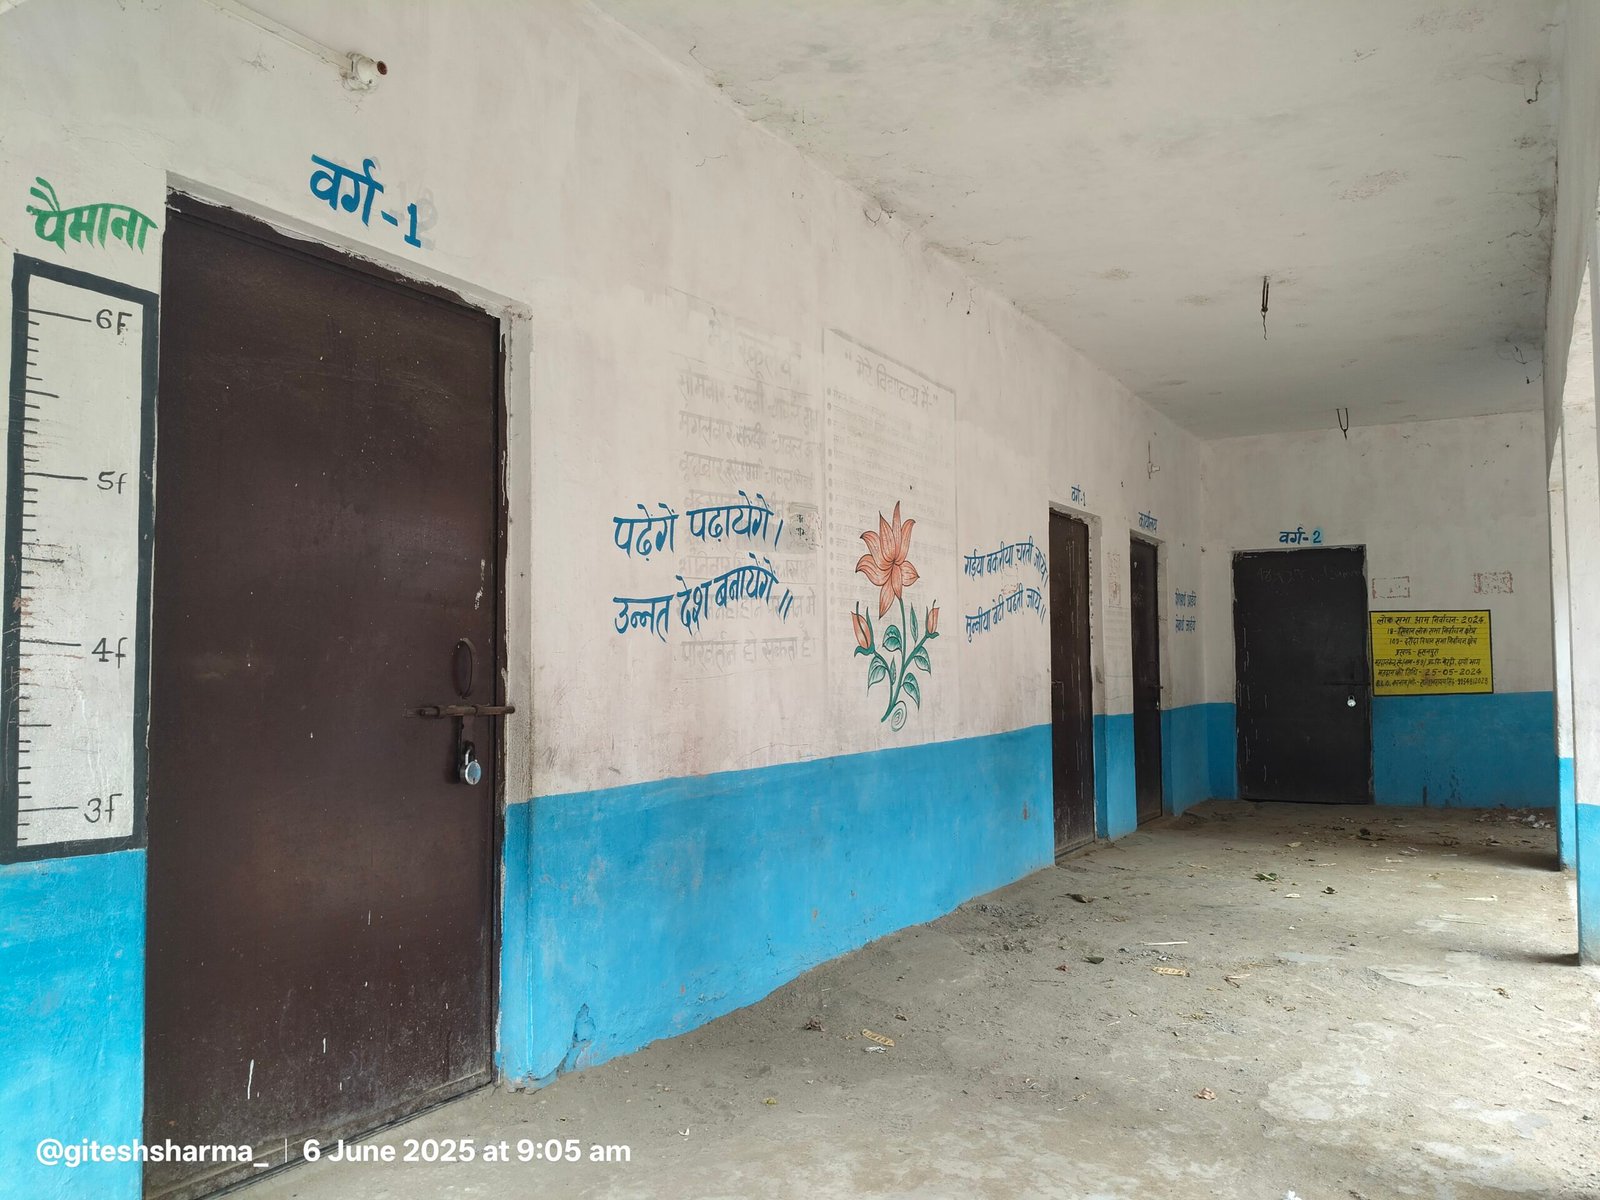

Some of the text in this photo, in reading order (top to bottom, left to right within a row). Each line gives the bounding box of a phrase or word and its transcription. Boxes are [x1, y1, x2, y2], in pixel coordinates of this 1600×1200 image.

[26, 176, 159, 255] पैमाना
[612, 594, 674, 643] उन्नत
[675, 575, 713, 636] देश
[1377, 614, 1393, 626] लोक
[1394, 616, 1411, 626] सभा
[1414, 616, 1430, 625] आम
[1461, 615, 1484, 625] 2024
